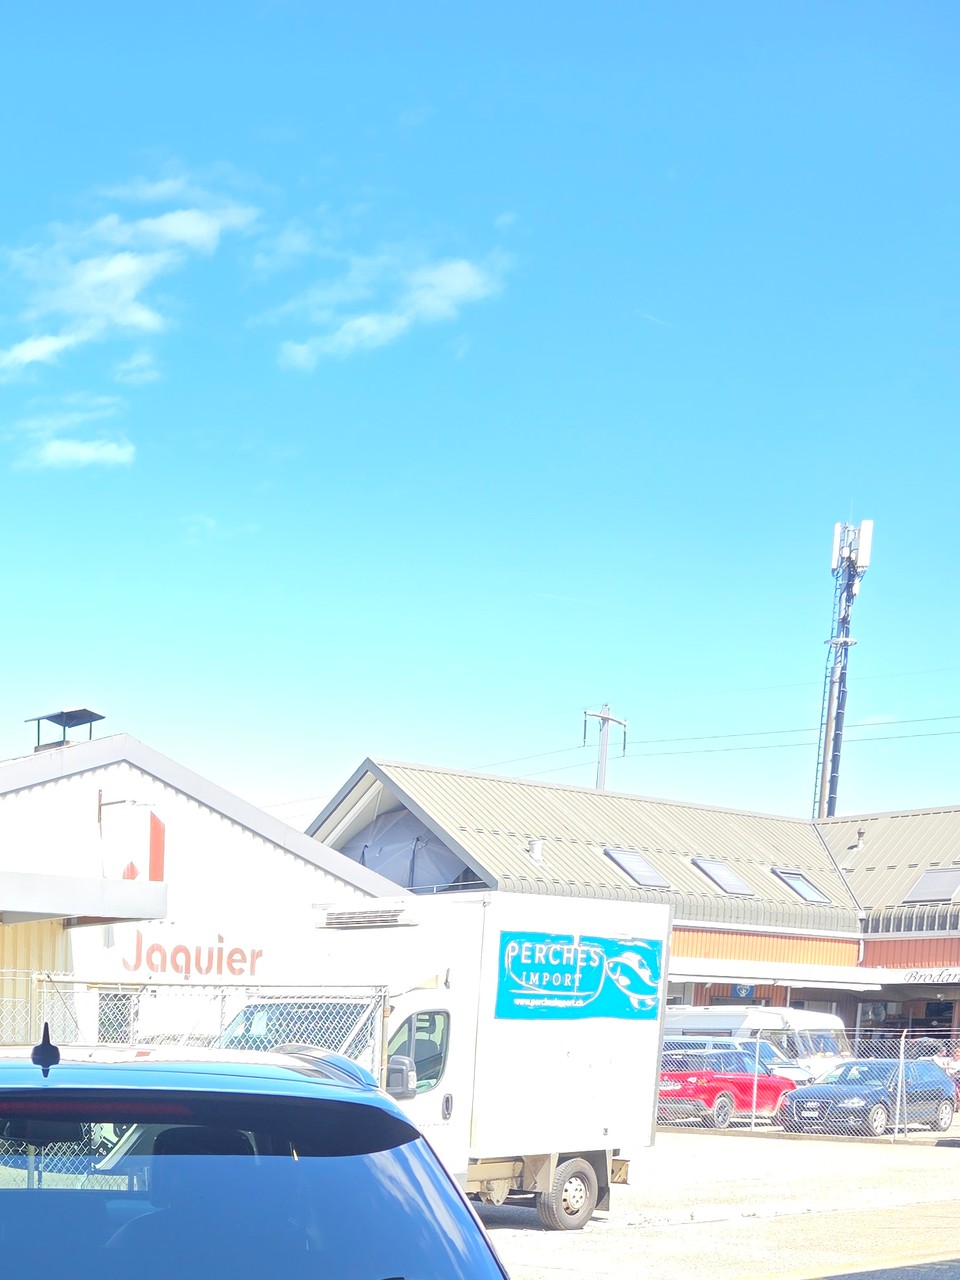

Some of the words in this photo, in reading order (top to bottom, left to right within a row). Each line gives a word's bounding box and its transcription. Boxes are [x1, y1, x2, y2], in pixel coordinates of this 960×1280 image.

[122, 929, 264, 980] Jaquier
[509, 942, 600, 967] PERCHES
[522, 971, 583, 987] IMPORT
[904, 968, 960, 983] Brodar
